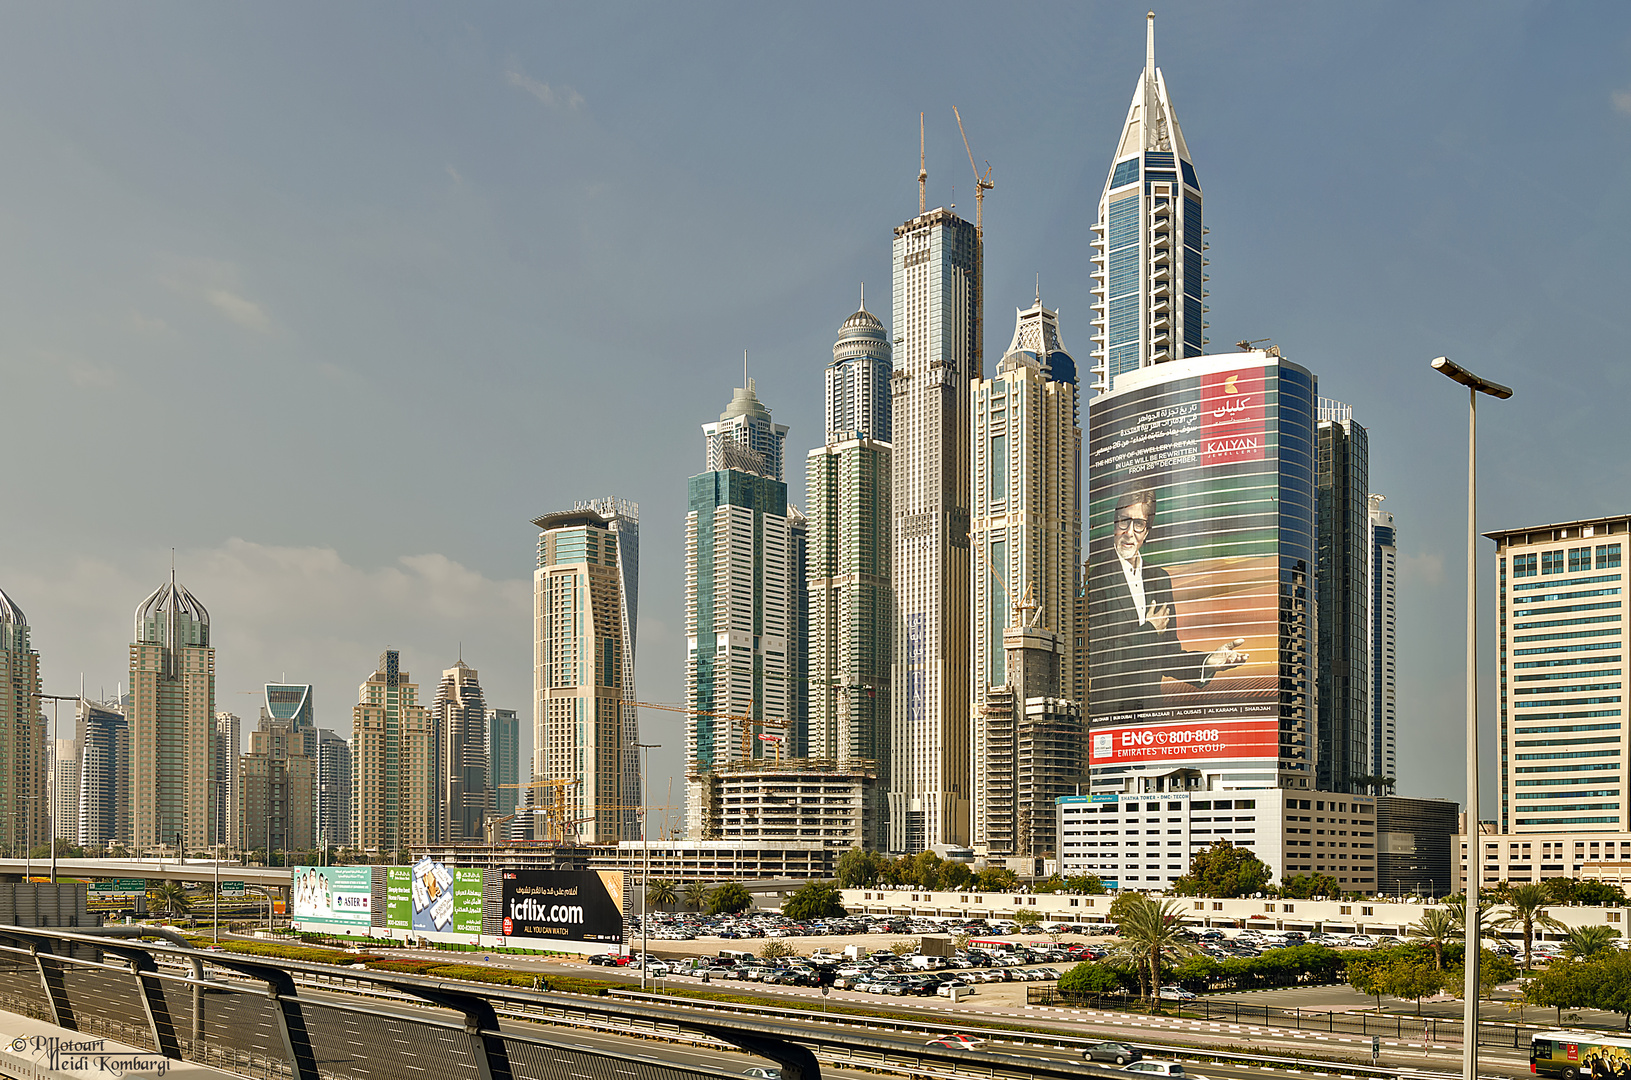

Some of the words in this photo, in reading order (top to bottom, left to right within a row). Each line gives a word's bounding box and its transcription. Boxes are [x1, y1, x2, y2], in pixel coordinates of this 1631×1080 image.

[1213, 397, 1251, 418] كليان
[1207, 437, 1257, 453] KALYAN
[1095, 459, 1104, 468] THE
[1104, 453, 1127, 465] HISTORY
[1135, 443, 1173, 457] JEWELLERY
[1122, 459, 1134, 468] UAE
[1134, 456, 1149, 466] WILL
[1149, 454, 1158, 462] BE
[1158, 447, 1198, 461] REWRITTEN
[1128, 465, 1146, 475] FROM
[1122, 731, 1154, 746] ENG
[1169, 729, 1219, 744] 800-808
[1117, 747, 1157, 758] EMIRATES
[1161, 746, 1187, 755] NEON
[1191, 743, 1226, 753] GROUP
[344, 896, 361, 907] ASTER
[510, 898, 584, 924] icflix.com
[533, 926, 543, 934] YOU
[542, 926, 553, 934] CAN
